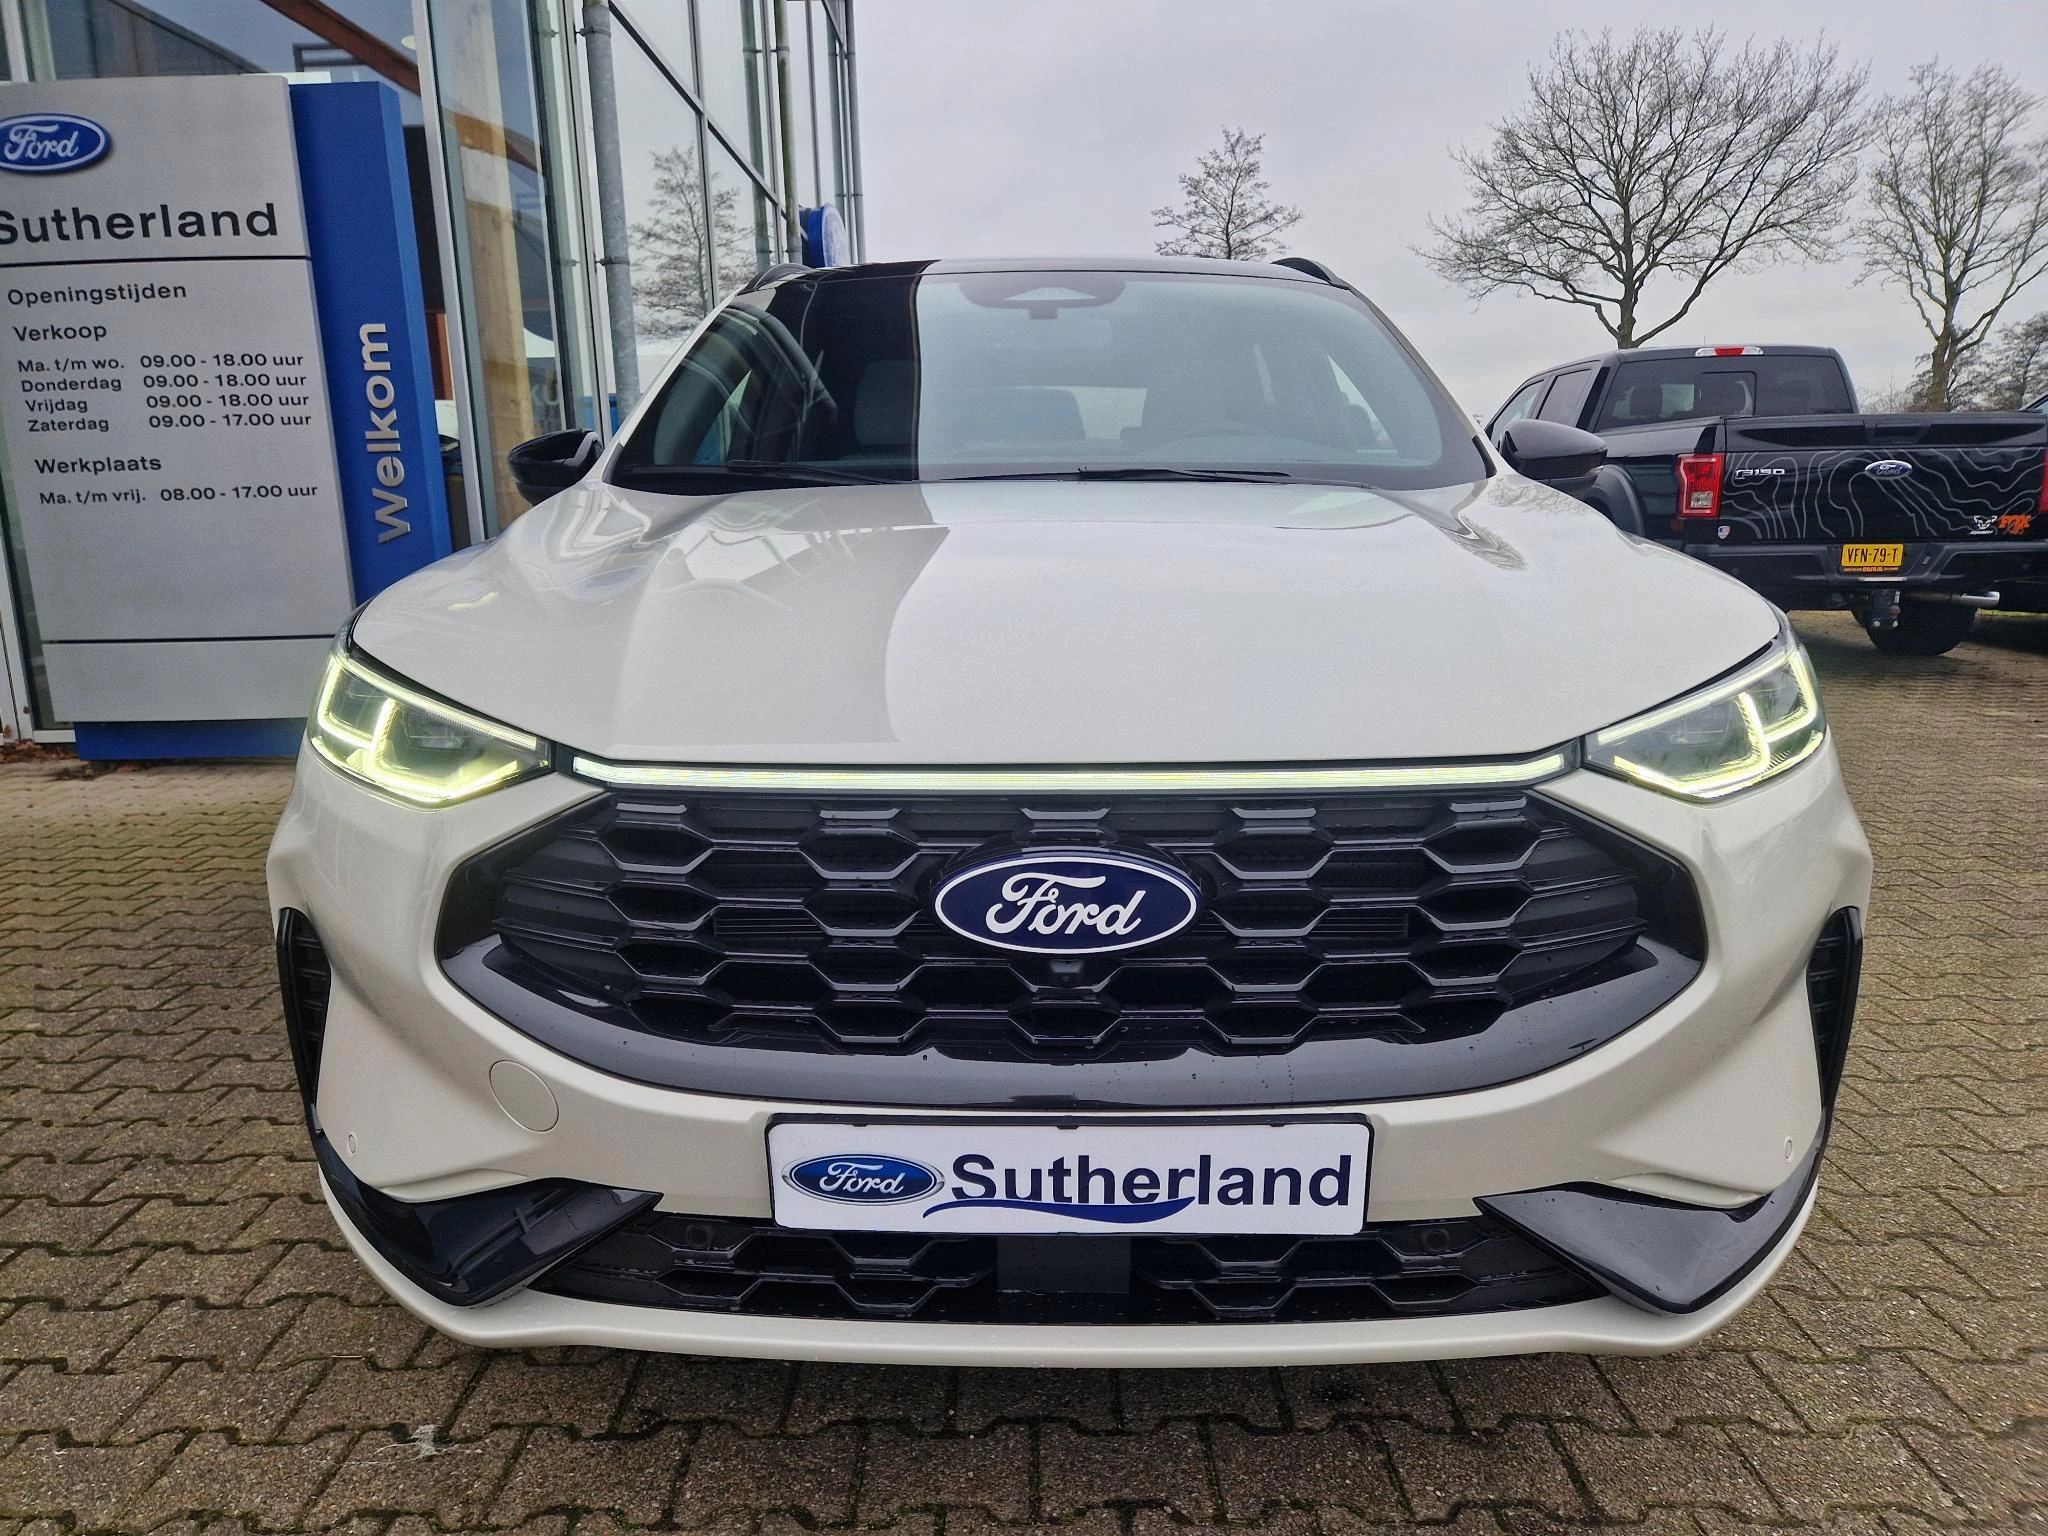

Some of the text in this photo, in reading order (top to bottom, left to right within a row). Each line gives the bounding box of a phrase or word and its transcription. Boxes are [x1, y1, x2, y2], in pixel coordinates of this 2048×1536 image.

[4, 124, 79, 160] Ford
[0, 203, 278, 245] Sutherland
[8, 284, 187, 307] Openingstijden
[13, 324, 108, 342] Verkoop
[18, 359, 50, 373] Ma.
[54, 357, 87, 371] t/m
[92, 358, 125, 370] wo.
[140, 354, 196, 368] 09.00
[213, 353, 267, 367] 18.00
[272, 354, 304, 367] uur
[21, 377, 122, 392] Donderdag
[143, 374, 199, 388] 09.00
[216, 373, 271, 387] 18.00
[275, 374, 307, 387] uur
[25, 398, 88, 414] Vrijdag
[146, 394, 202, 408] 09.00
[219, 393, 273, 407] 18.00
[278, 394, 310, 407] uur
[28, 417, 109, 433] Zaterdag
[149, 414, 205, 428] 09.00
[222, 413, 275, 427] 17.00
[280, 414, 312, 426] uur
[359, 323, 411, 544] Welkom
[35, 456, 162, 476] Werkplaats
[40, 491, 72, 505] Ma.
[75, 490, 108, 504] t/m
[113, 488, 147, 504] vrij.
[160, 487, 216, 502] 08.00
[232, 485, 283, 499] 17.00
[287, 485, 319, 498] uur
[1847, 547, 1899, 563] VFN-79-T
[985, 872, 1146, 935] Ford
[819, 1152, 1352, 1206] Ford Sutherland
